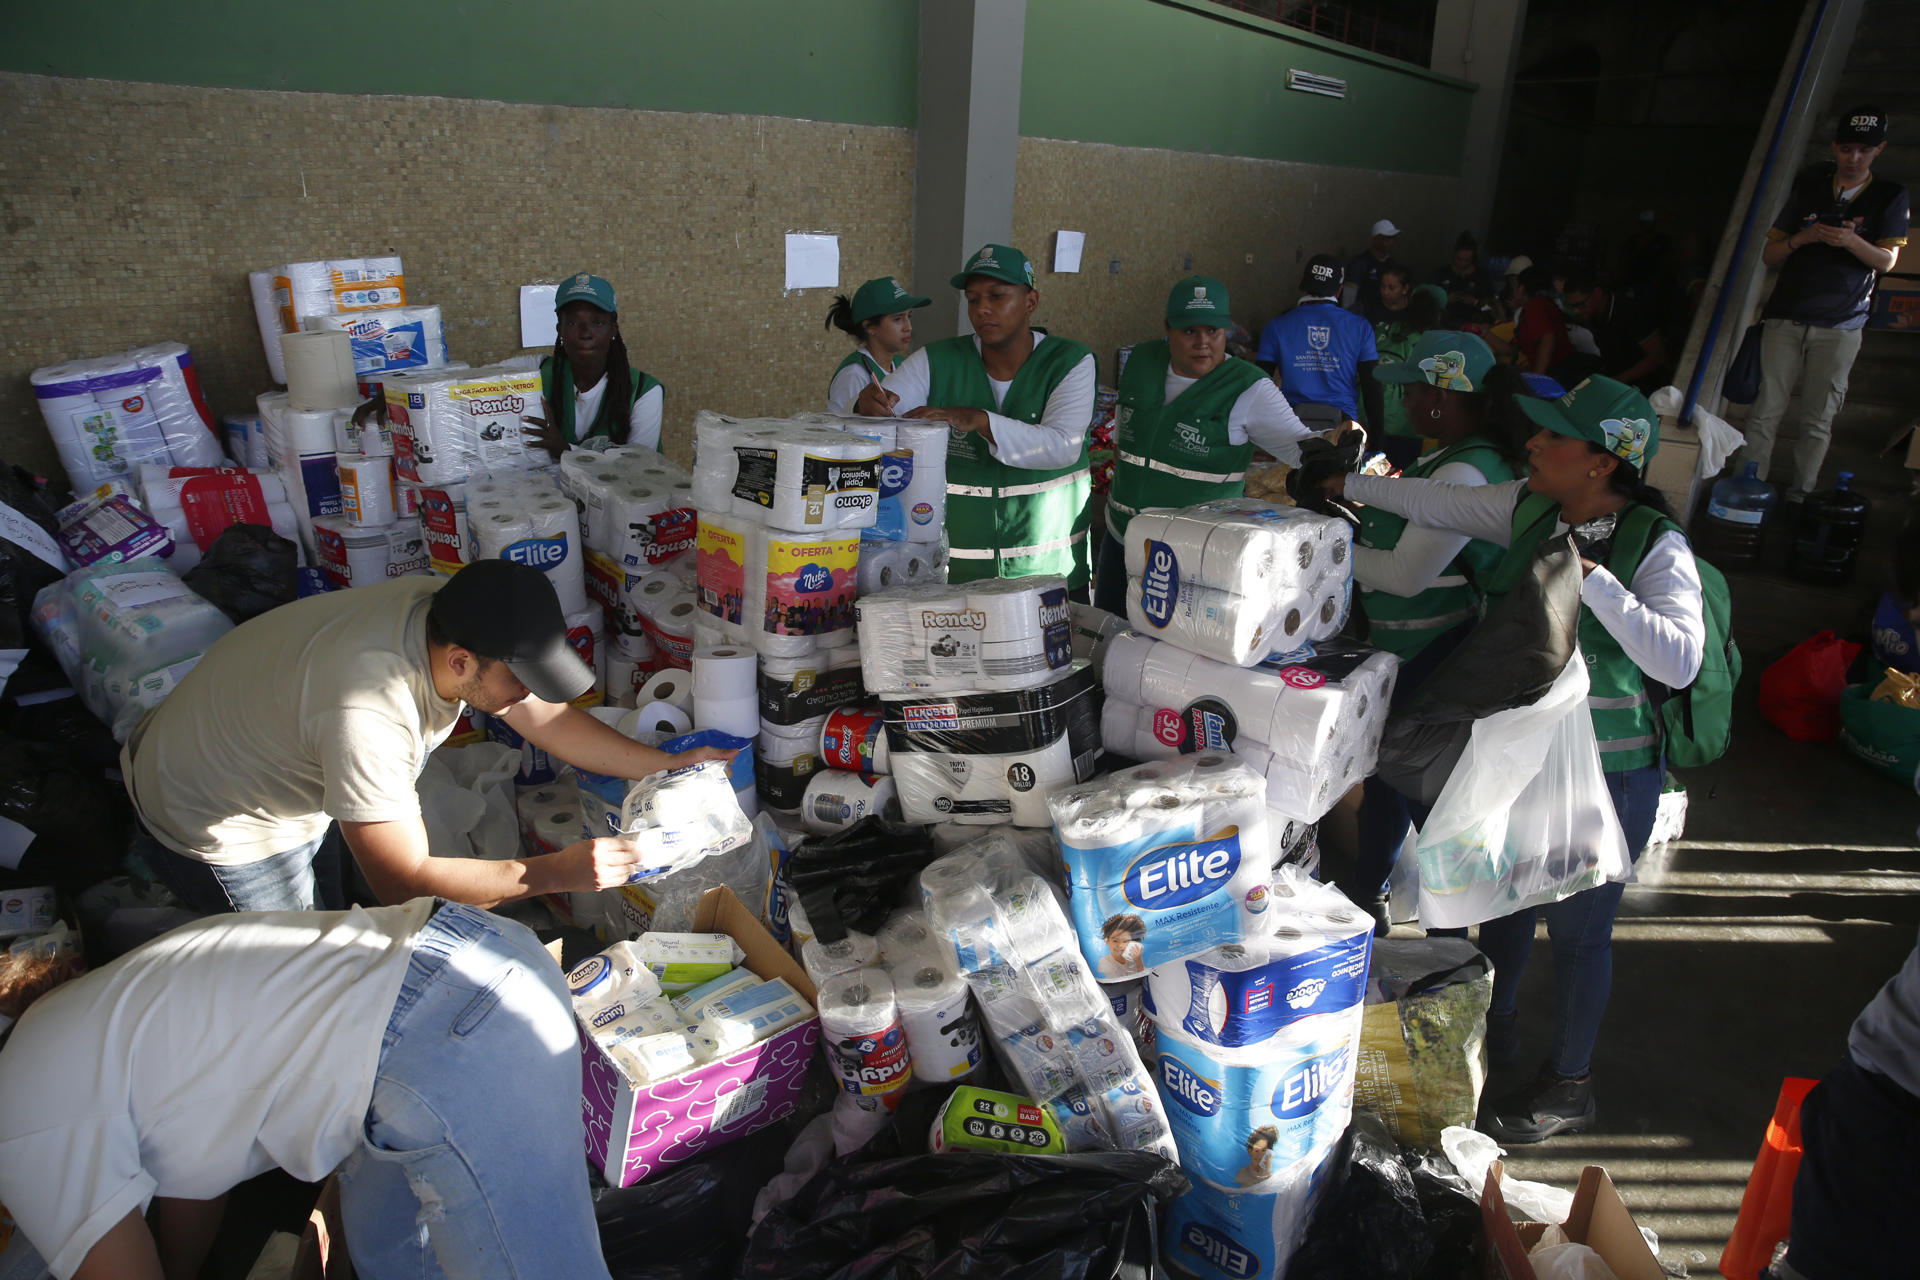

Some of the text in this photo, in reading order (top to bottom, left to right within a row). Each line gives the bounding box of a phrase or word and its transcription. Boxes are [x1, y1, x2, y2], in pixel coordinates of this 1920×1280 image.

[1850, 115, 1878, 127] SDR
[1311, 264, 1334, 278] SDR
[470, 395, 525, 415] Rendy
[1180, 430, 1206, 445] CALI
[844, 479, 864, 488] Papel
[320, 505, 344, 515] rong
[809, 505, 821, 516] 12
[836, 495, 873, 509] ekono
[424, 527, 461, 549] Rendy
[645, 537, 697, 558] Rendy
[708, 530, 737, 547] OFERTA
[510, 543, 562, 567] Elite
[791, 546, 833, 557] OFERTA
[586, 572, 618, 607] endy
[803, 570, 828, 589] Nube
[1147, 550, 1172, 619] Elite
[922, 608, 986, 630] Rendy
[799, 677, 811, 689] 12
[961, 718, 997, 728] PREMIUM
[1162, 714, 1180, 742] 30
[1191, 707, 1204, 751] FAMIPA
[839, 725, 852, 764] Rosal
[797, 762, 810, 771] 12
[1012, 766, 1030, 782] 18
[1139, 850, 1231, 901] Elite
[774, 867, 788, 925] Elit
[1155, 901, 1220, 928] MAX Resistente
[571, 961, 599, 984] winny
[1286, 979, 1328, 1001] Arbora
[592, 1003, 626, 1028] winny
[860, 1056, 909, 1082] ndy
[1358, 1050, 1372, 1075] MAS
[1163, 1061, 1215, 1113] Elite
[1281, 1052, 1350, 1112] Elite
[979, 1101, 991, 1111] 22
[1019, 1107, 1040, 1115] SWEET
[970, 1122, 984, 1131] RN
[1019, 1113, 1040, 1122] BABY
[1188, 1226, 1249, 1275] Elite
